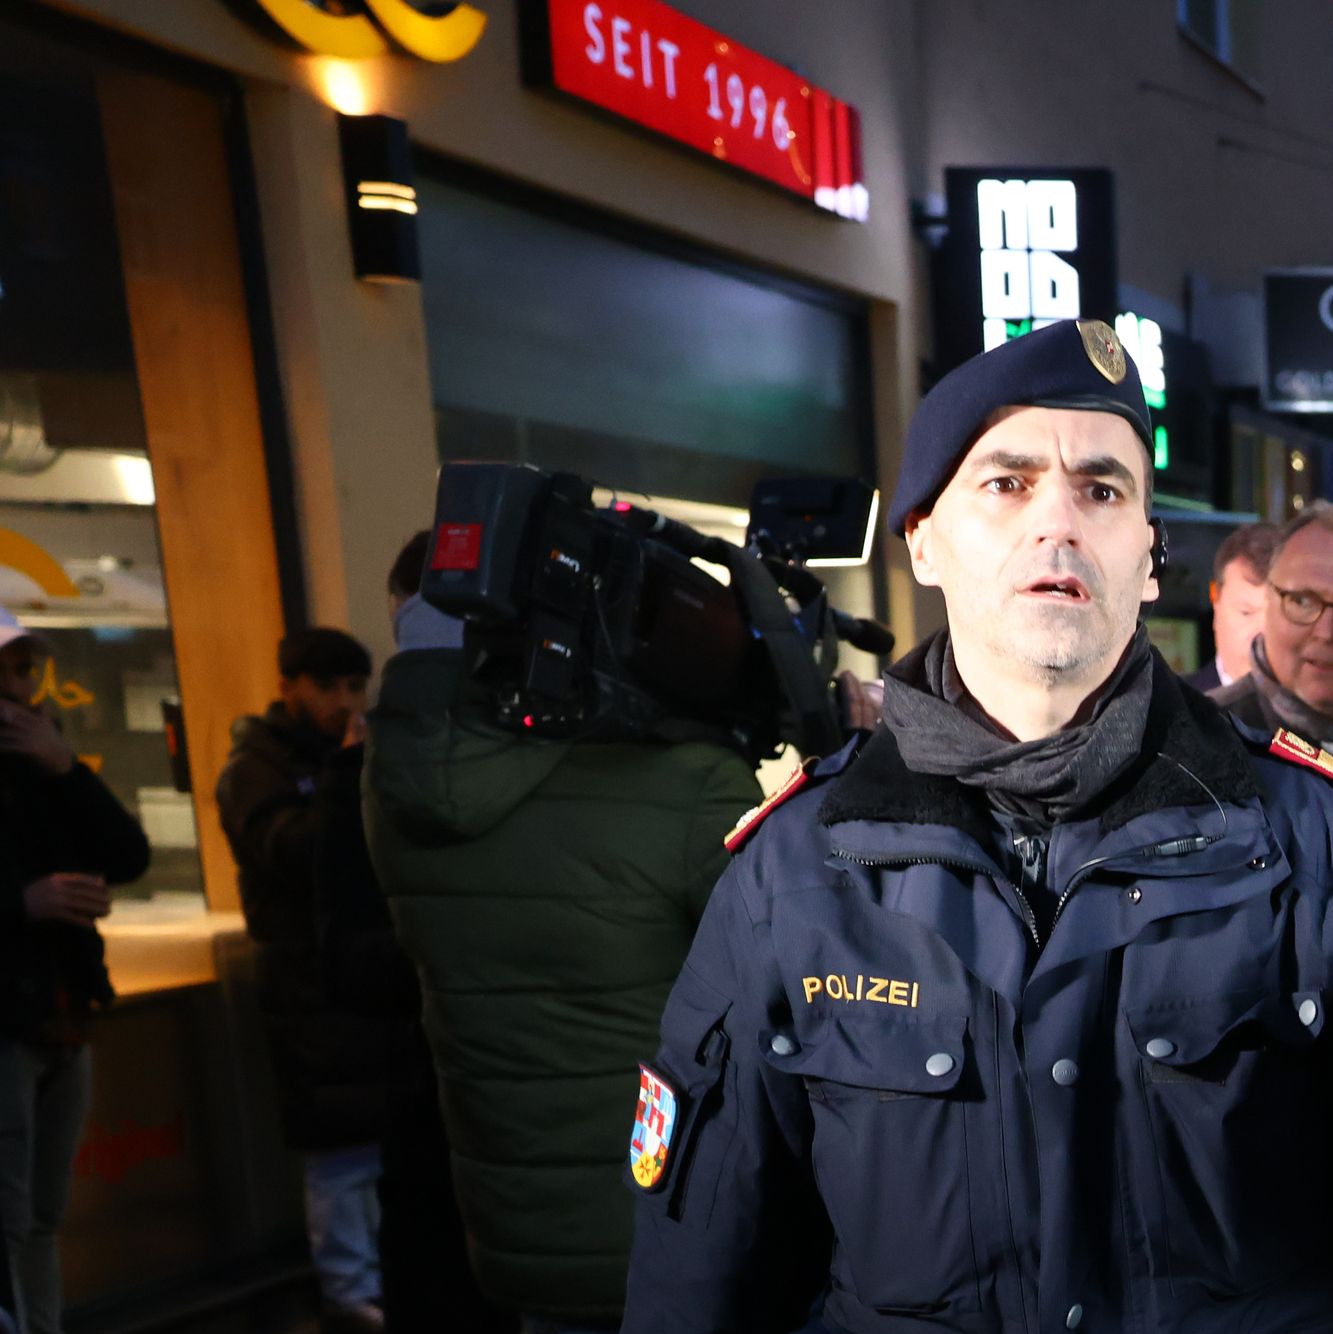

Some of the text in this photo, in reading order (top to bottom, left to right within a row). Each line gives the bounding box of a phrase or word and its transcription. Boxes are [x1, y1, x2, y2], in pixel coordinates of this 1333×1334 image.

[583, 2, 680, 100] SEIT
[704, 62, 790, 151] 1996
[802, 974, 919, 1008] POLIZEI
